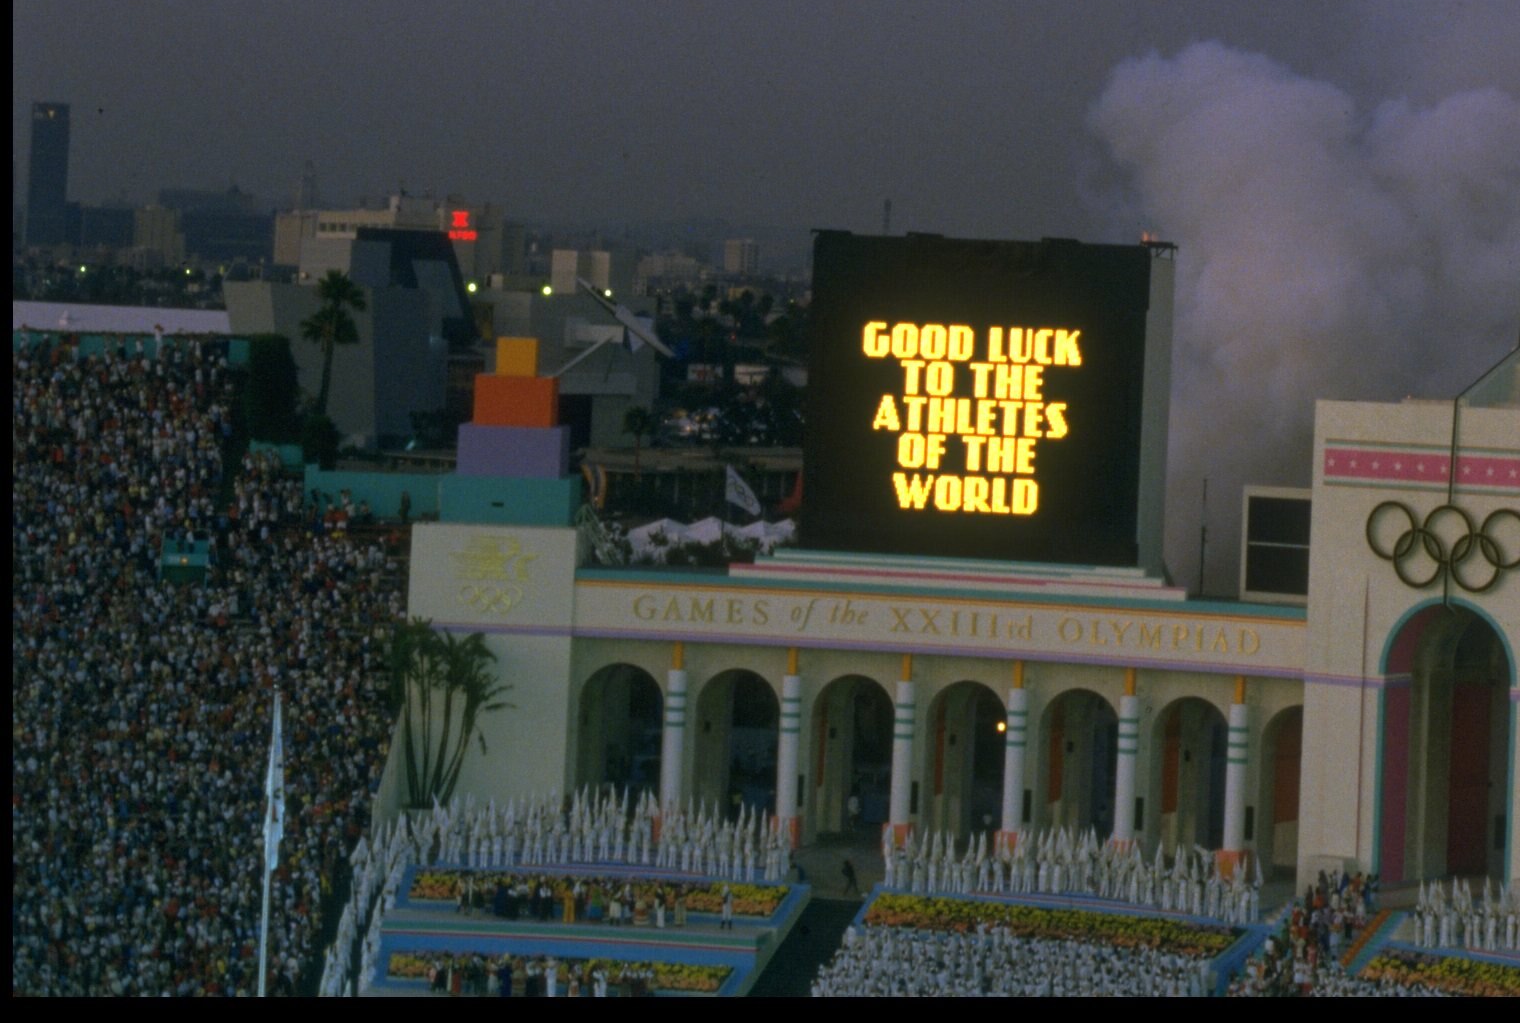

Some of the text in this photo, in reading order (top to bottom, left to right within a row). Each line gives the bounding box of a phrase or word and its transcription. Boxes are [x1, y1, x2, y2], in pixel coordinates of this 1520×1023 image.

[862, 321, 1081, 366] GOOD LUCK
[900, 359, 1044, 400] TO THE
[872, 394, 1068, 439] ATHLETES
[897, 431, 1036, 474] OF THE
[892, 471, 1039, 515] WORLD
[632, 594, 770, 626] GAMES
[790, 599, 816, 632] of
[829, 600, 868, 625] the
[1057, 617, 1260, 656] OLYMPIAD
